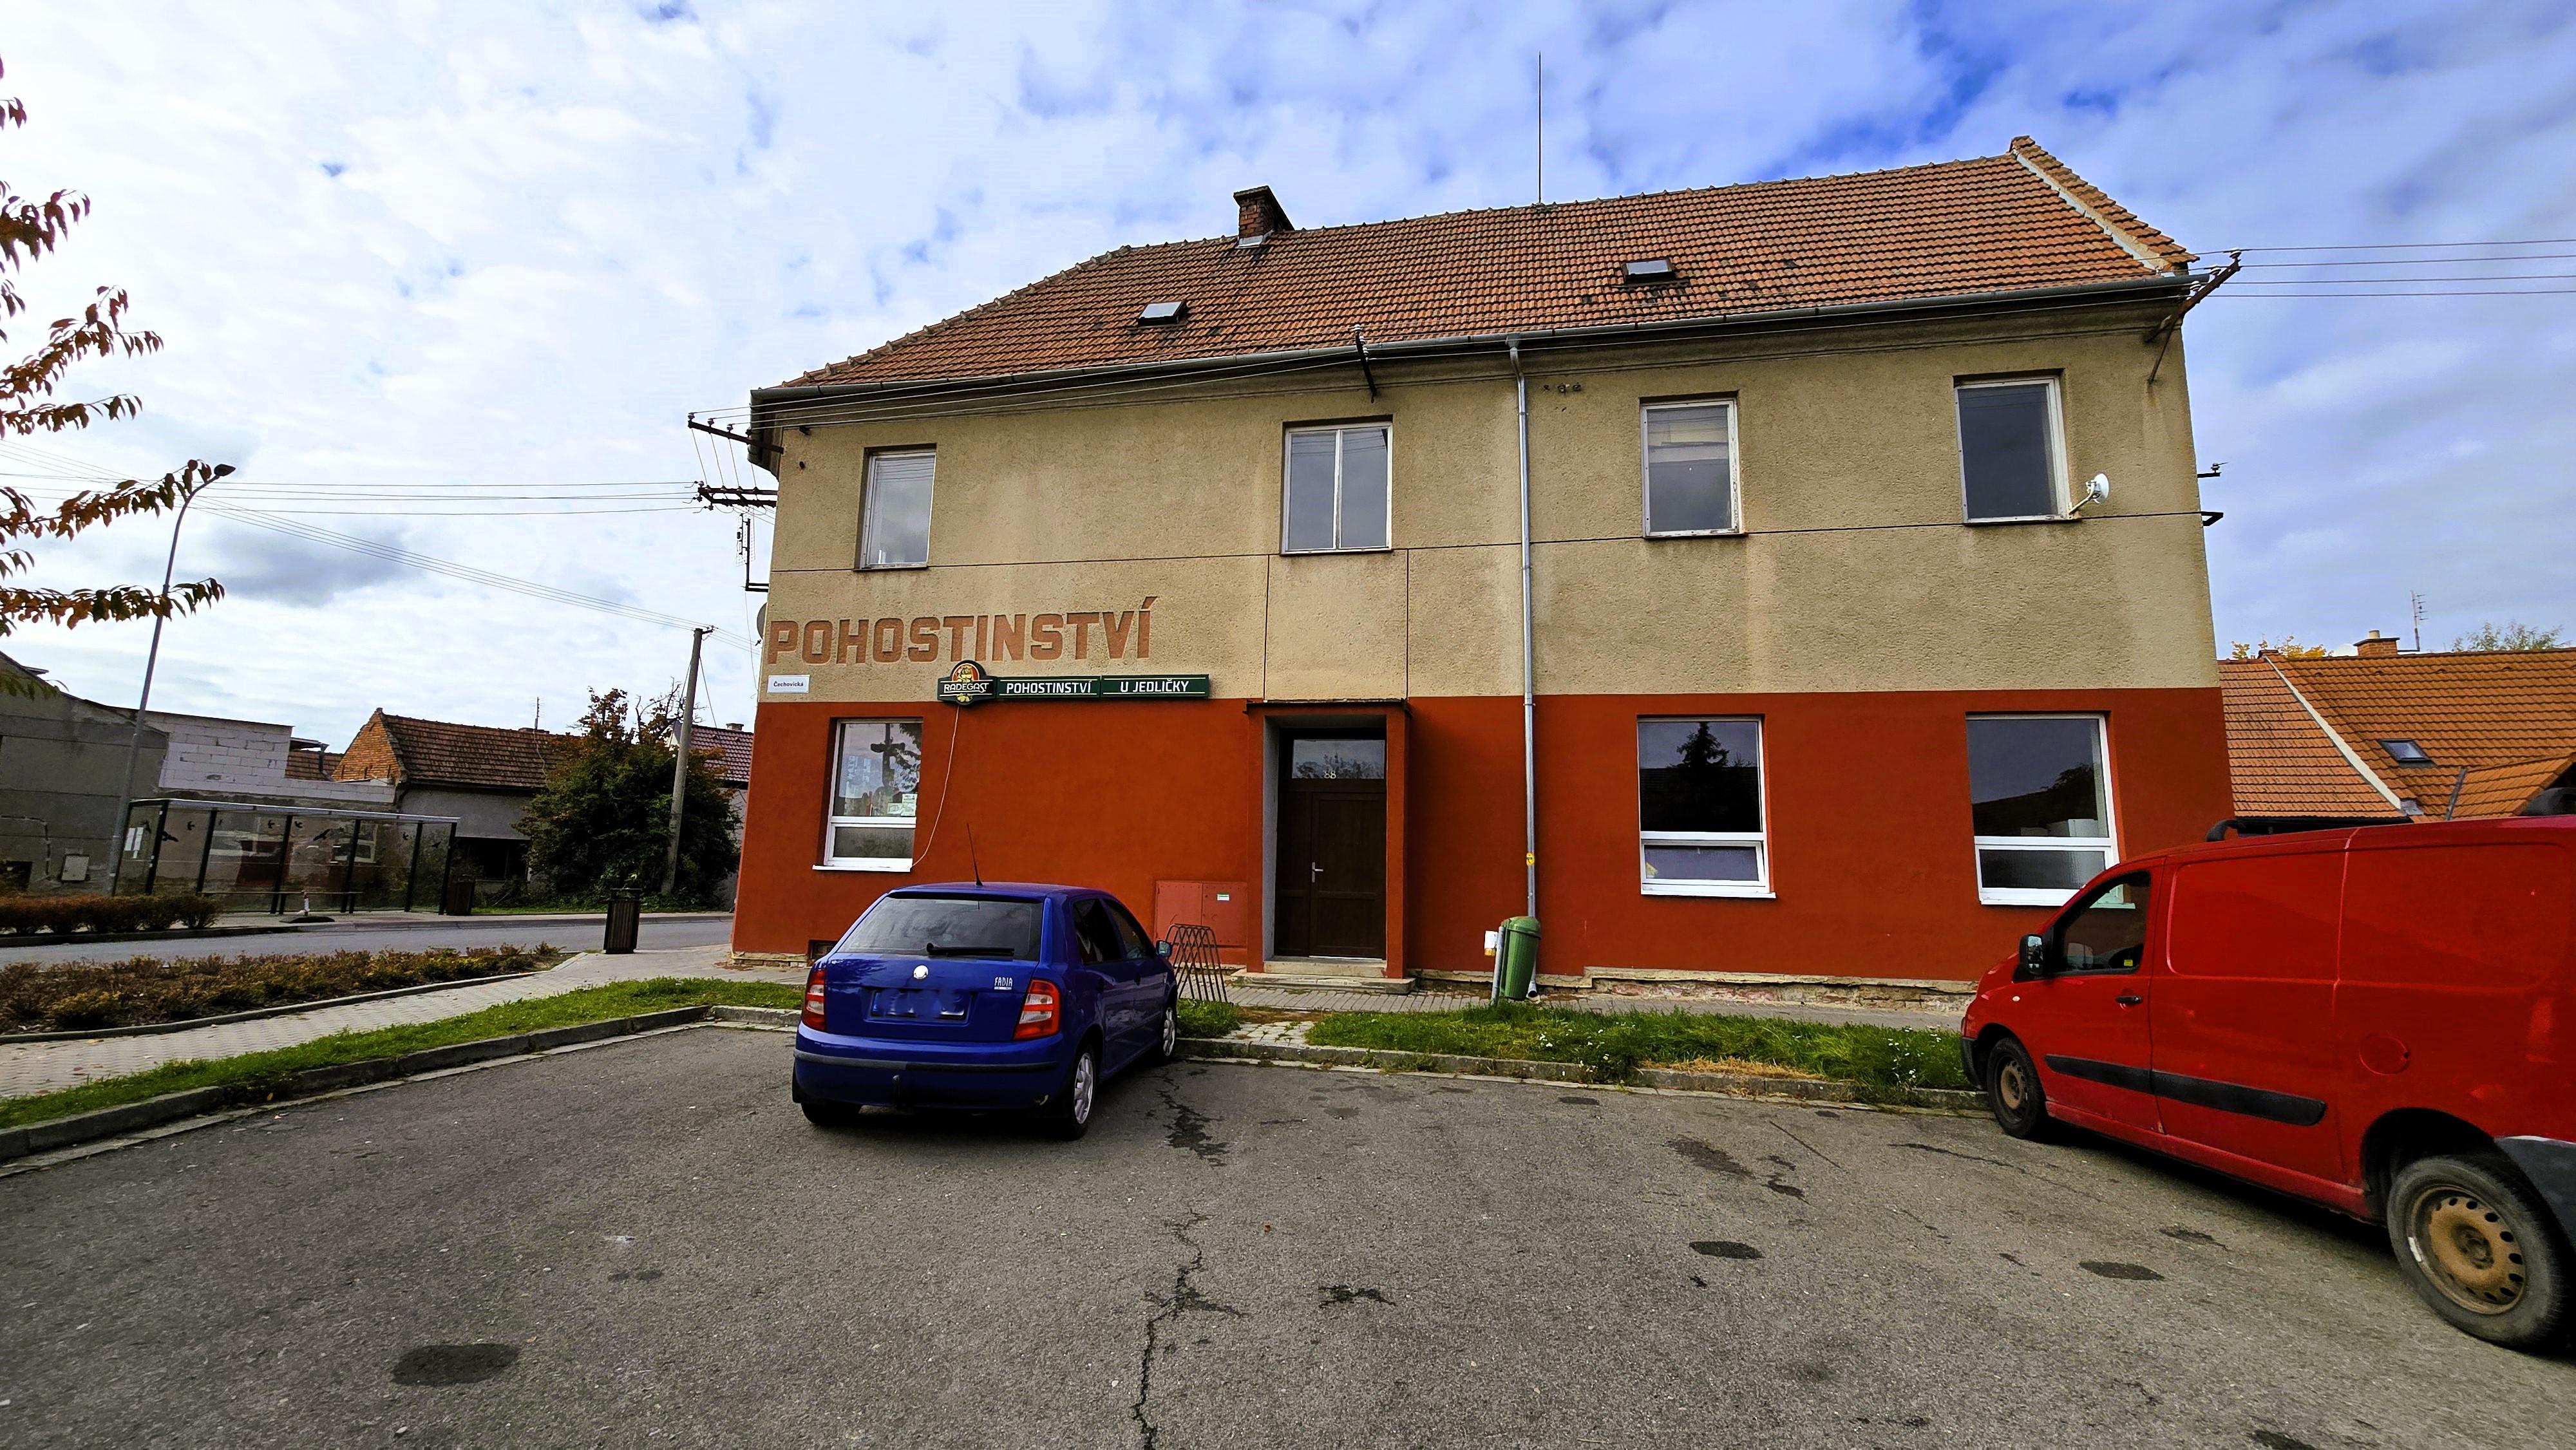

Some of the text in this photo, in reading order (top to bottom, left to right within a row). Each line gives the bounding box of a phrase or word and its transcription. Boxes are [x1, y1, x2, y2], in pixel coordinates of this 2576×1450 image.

[767, 596, 1157, 663] POHOSTINSTVÍ
[943, 683, 990, 693] RADEGAST
[1006, 678, 1189, 693] POHOSTINSTVÍ U JEDLIČKY
